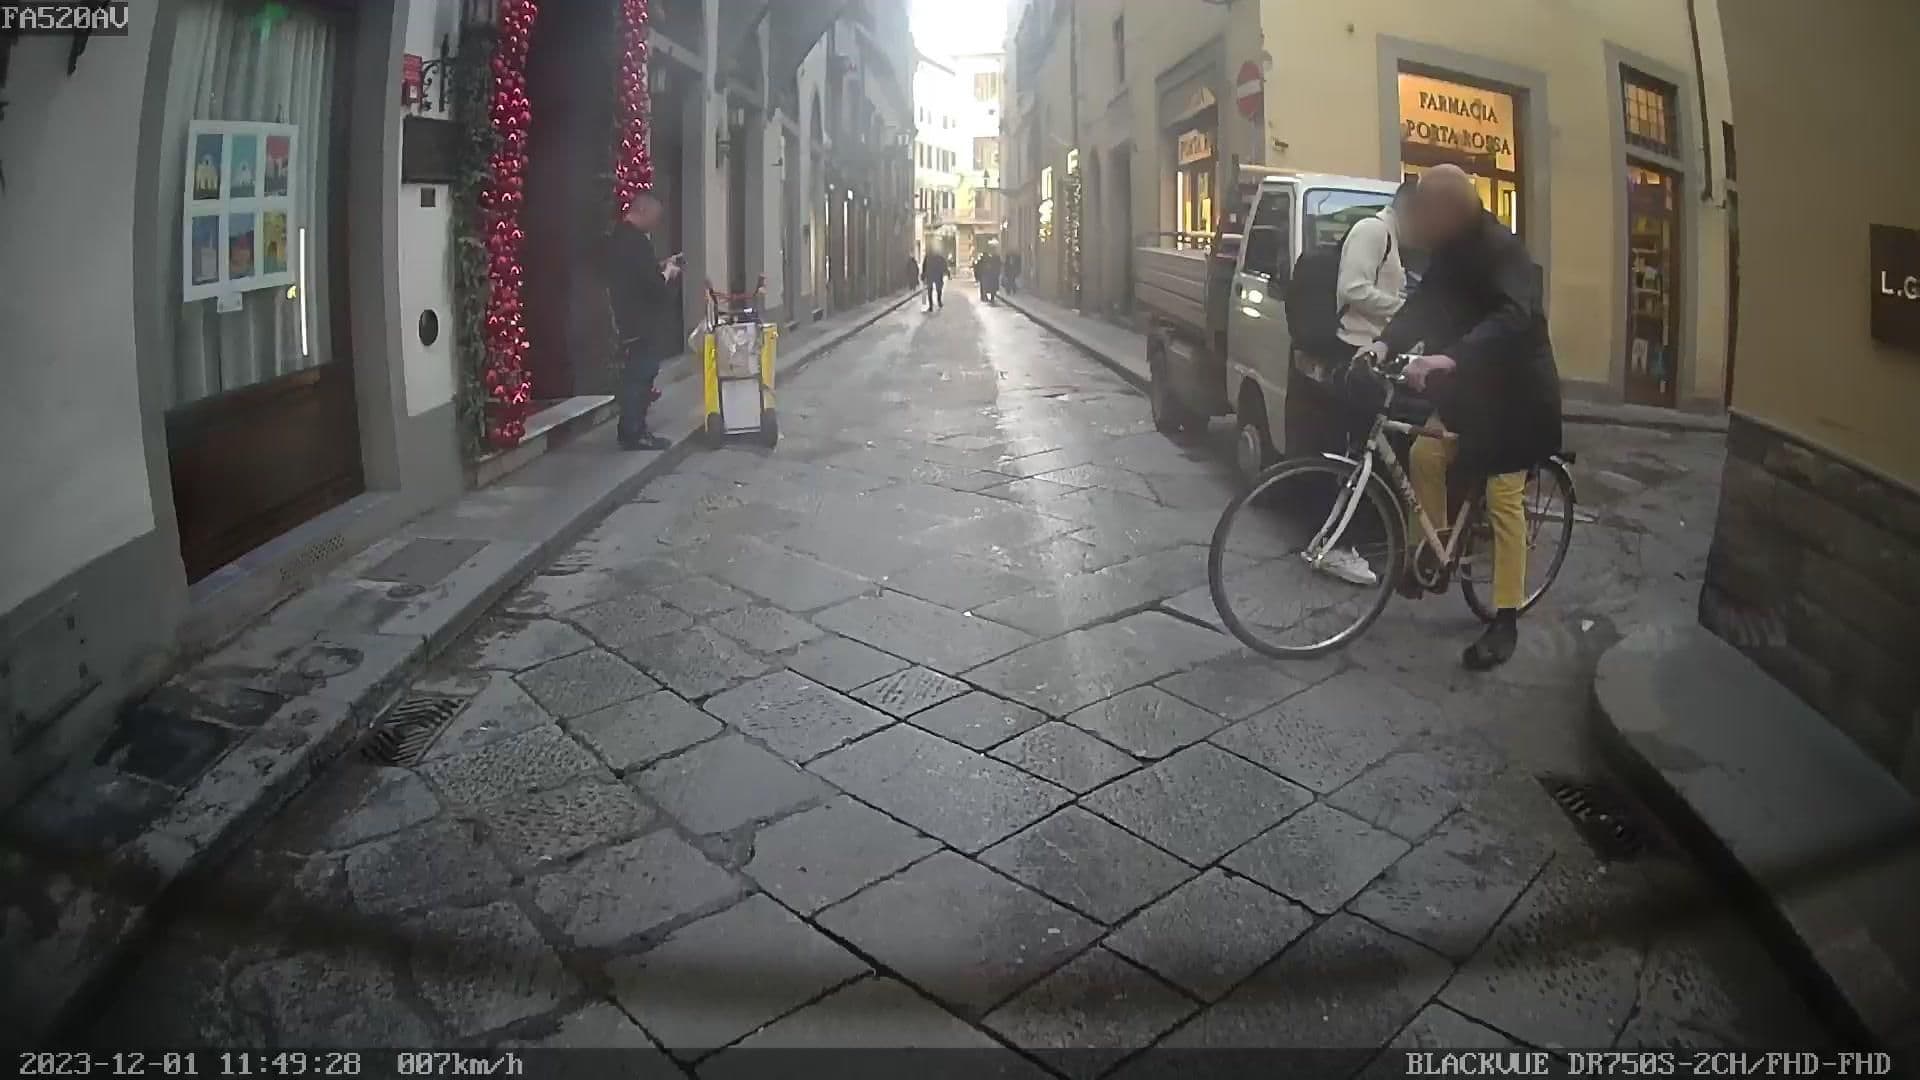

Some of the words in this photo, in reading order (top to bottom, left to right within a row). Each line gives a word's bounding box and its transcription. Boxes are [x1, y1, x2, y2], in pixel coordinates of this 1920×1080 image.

[1419, 91, 1498, 123] FARMACIA
[1406, 119, 1458, 145] PORTA
[1461, 128, 1512, 155] ROSSA
